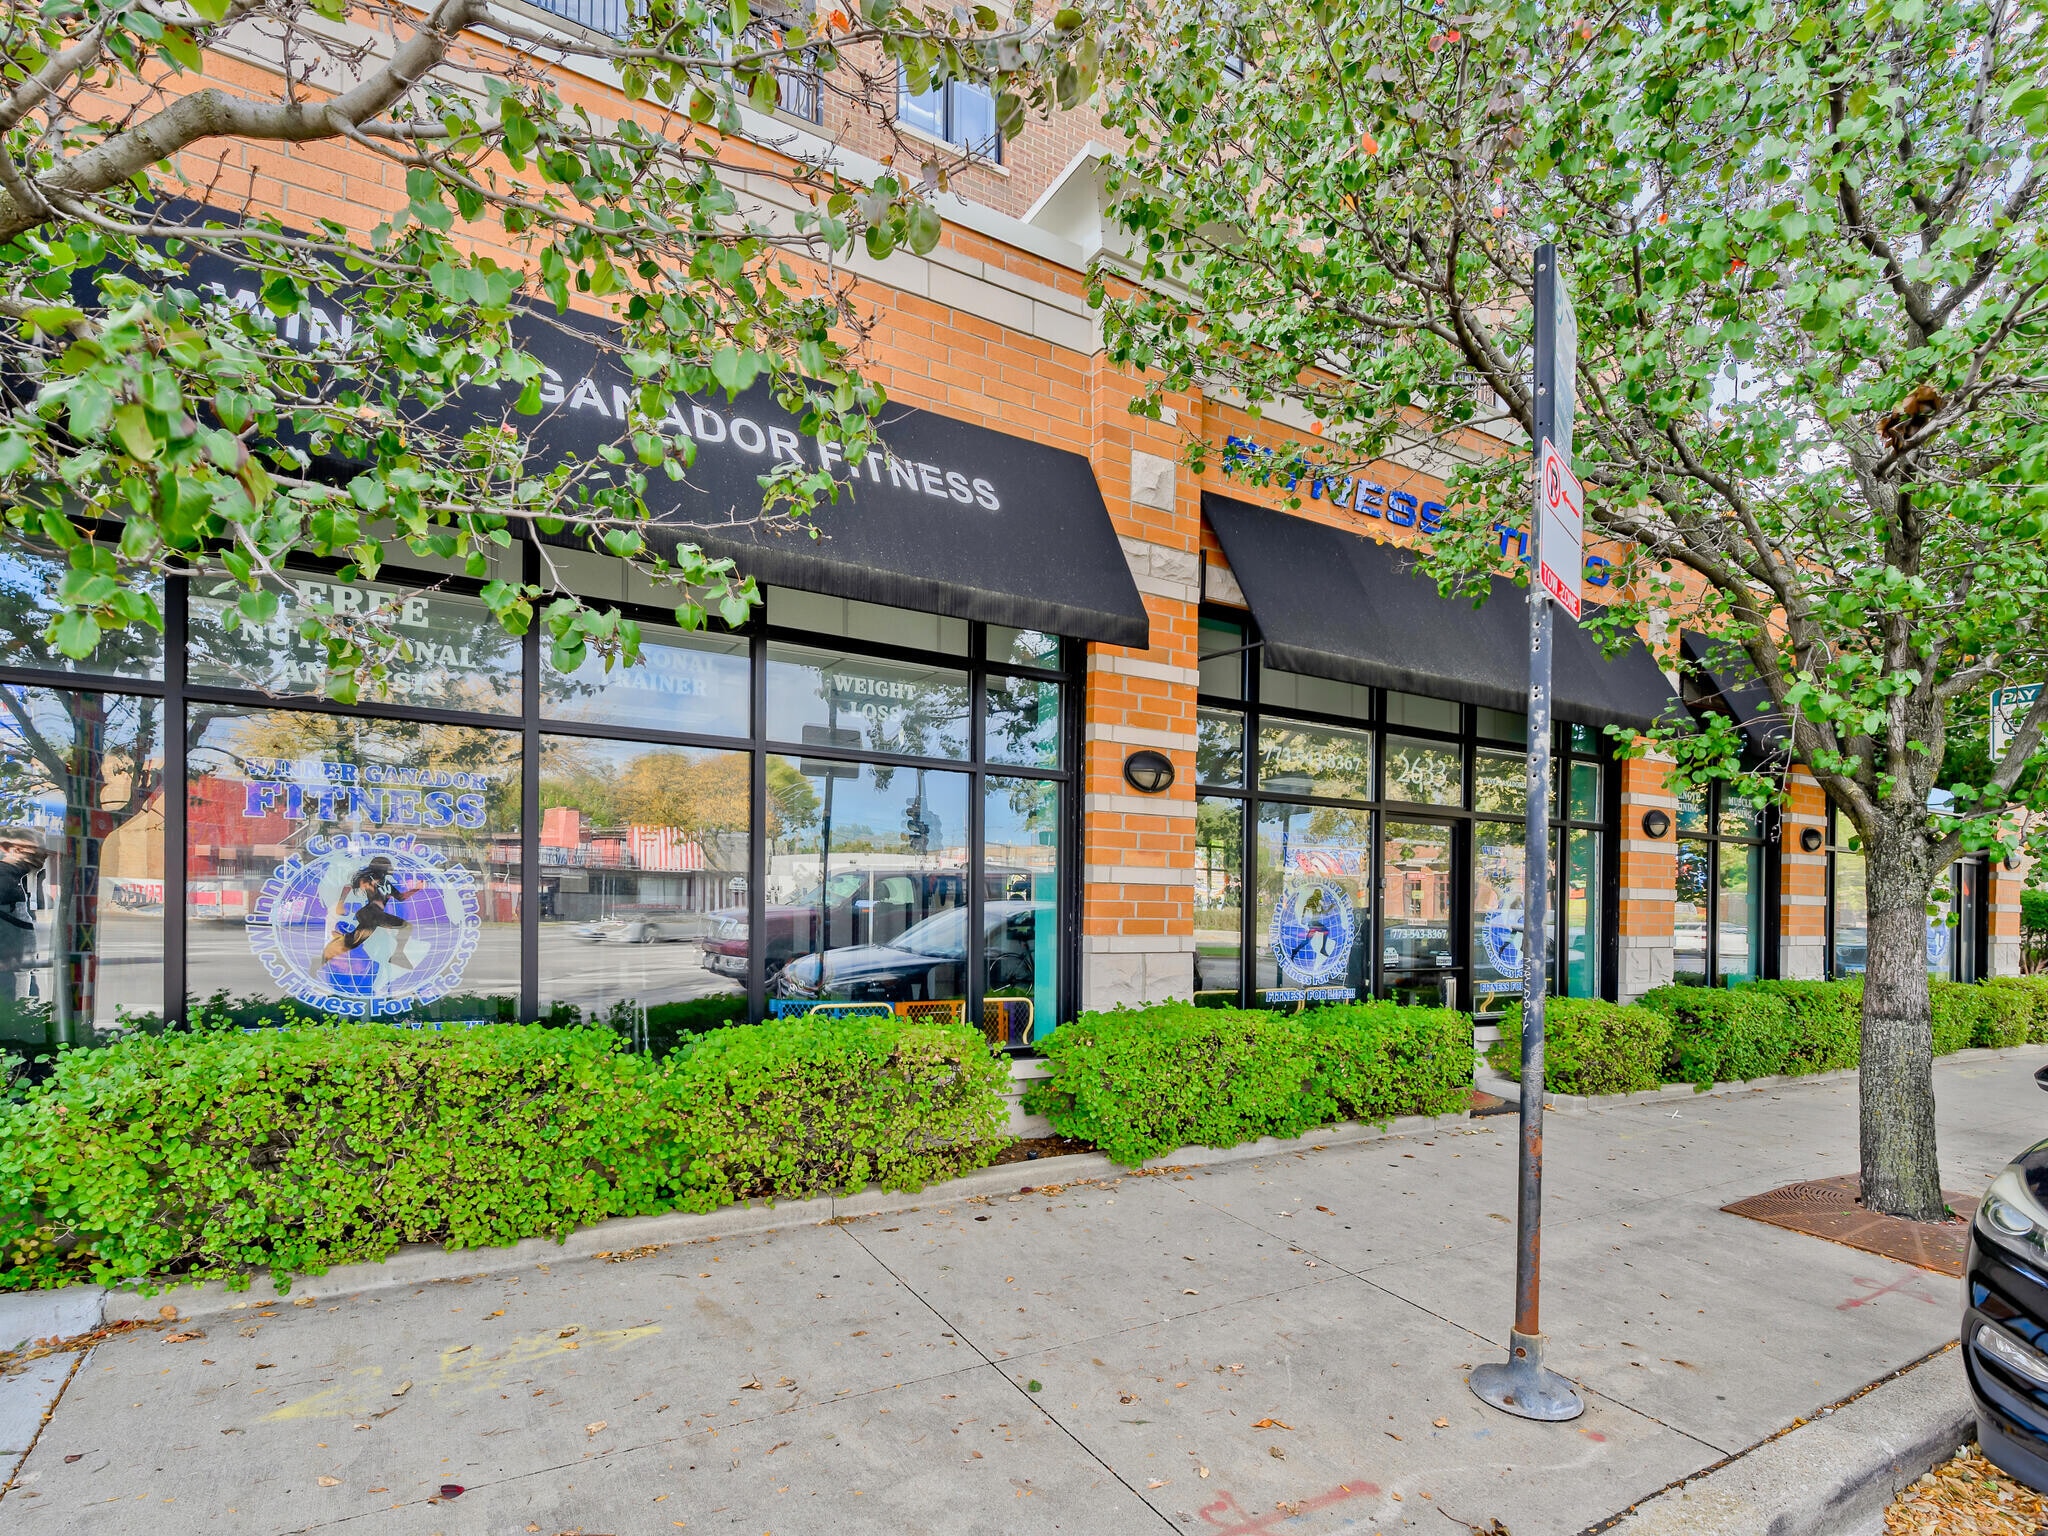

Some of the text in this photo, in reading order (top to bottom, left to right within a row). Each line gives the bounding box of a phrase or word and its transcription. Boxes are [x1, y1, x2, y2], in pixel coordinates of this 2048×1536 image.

[1543, 564, 1578, 616] TOW ZONE
[832, 674, 916, 700] WEIGHT
[2002, 688, 2037, 704] PAY
[850, 701, 902, 722] LOSS
[245, 757, 487, 791] WINNER GANADOR
[1397, 753, 1447, 793] 2633
[242, 779, 487, 829] FITNESS
[245, 832, 482, 955] Winner Ganador Fitness
[1390, 928, 1447, 939] 773-543-8367
[275, 970, 464, 1017] Fitness For Life
[1265, 989, 1306, 1003] FITNESS
[1306, 989, 1327, 1001] FOR
